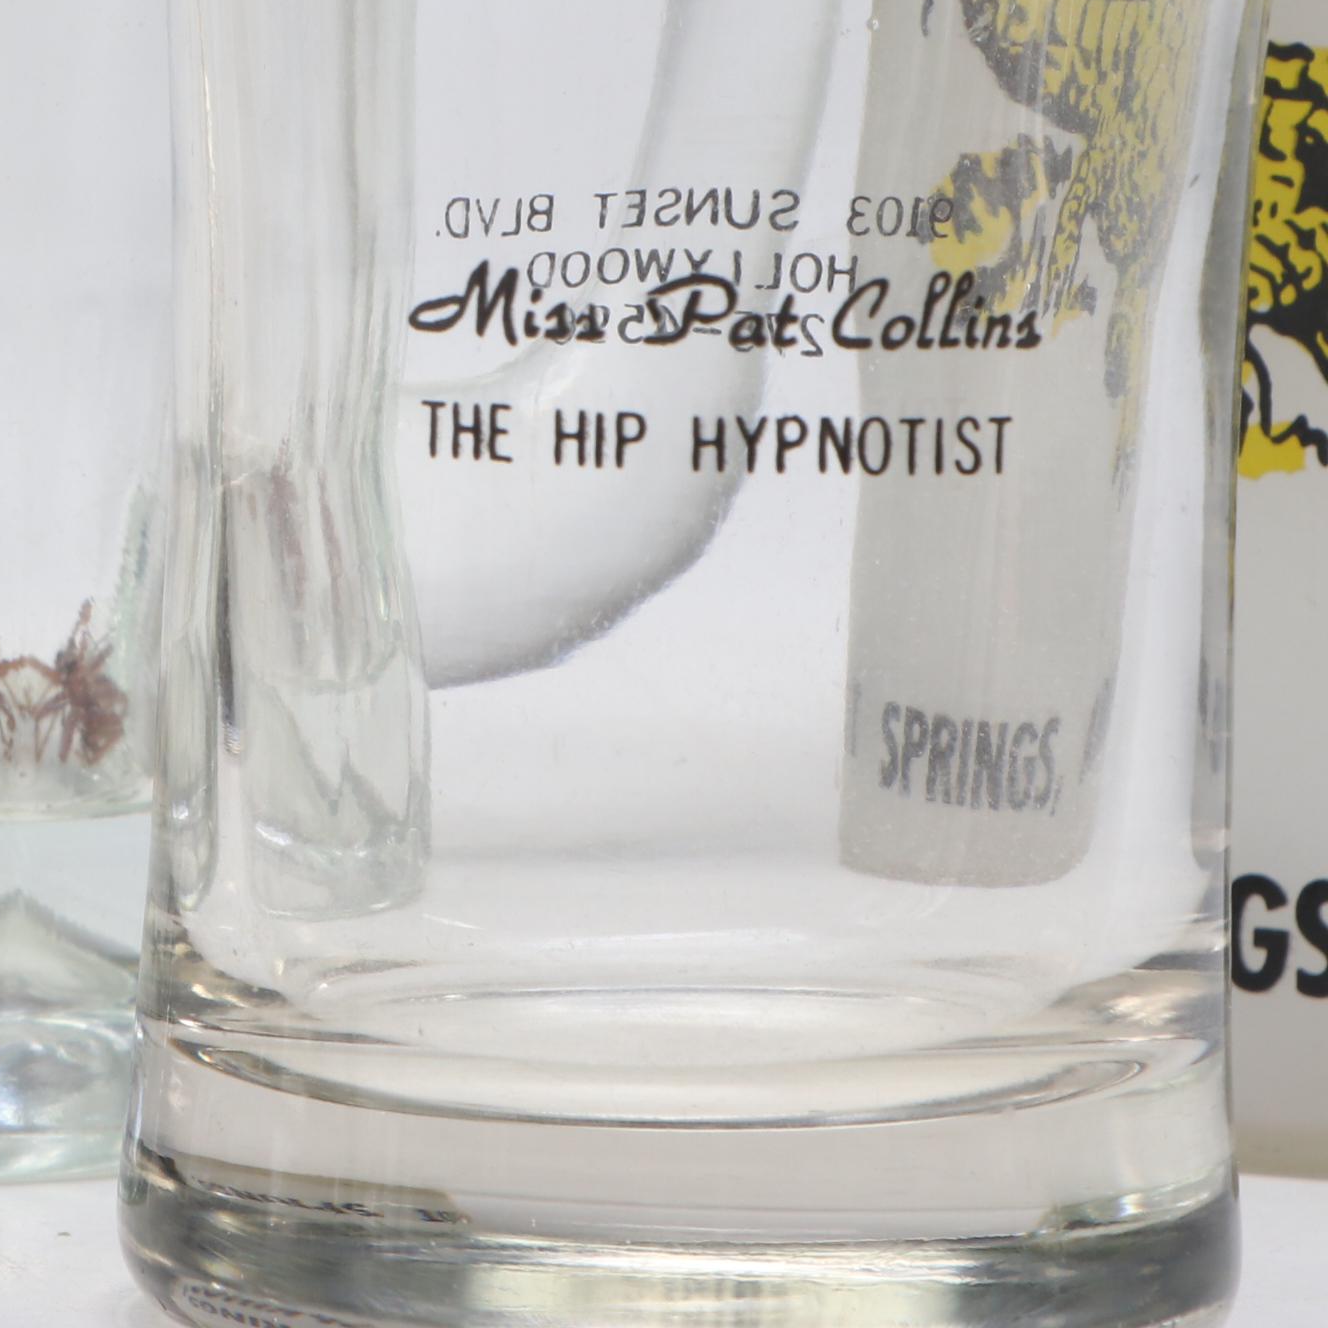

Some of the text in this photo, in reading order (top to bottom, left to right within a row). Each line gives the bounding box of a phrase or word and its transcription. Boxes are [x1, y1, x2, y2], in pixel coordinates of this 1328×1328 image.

[408, 259, 1042, 350] Miss Pat Collins
[421, 399, 1014, 476] THE HIP HYPNOTIST
